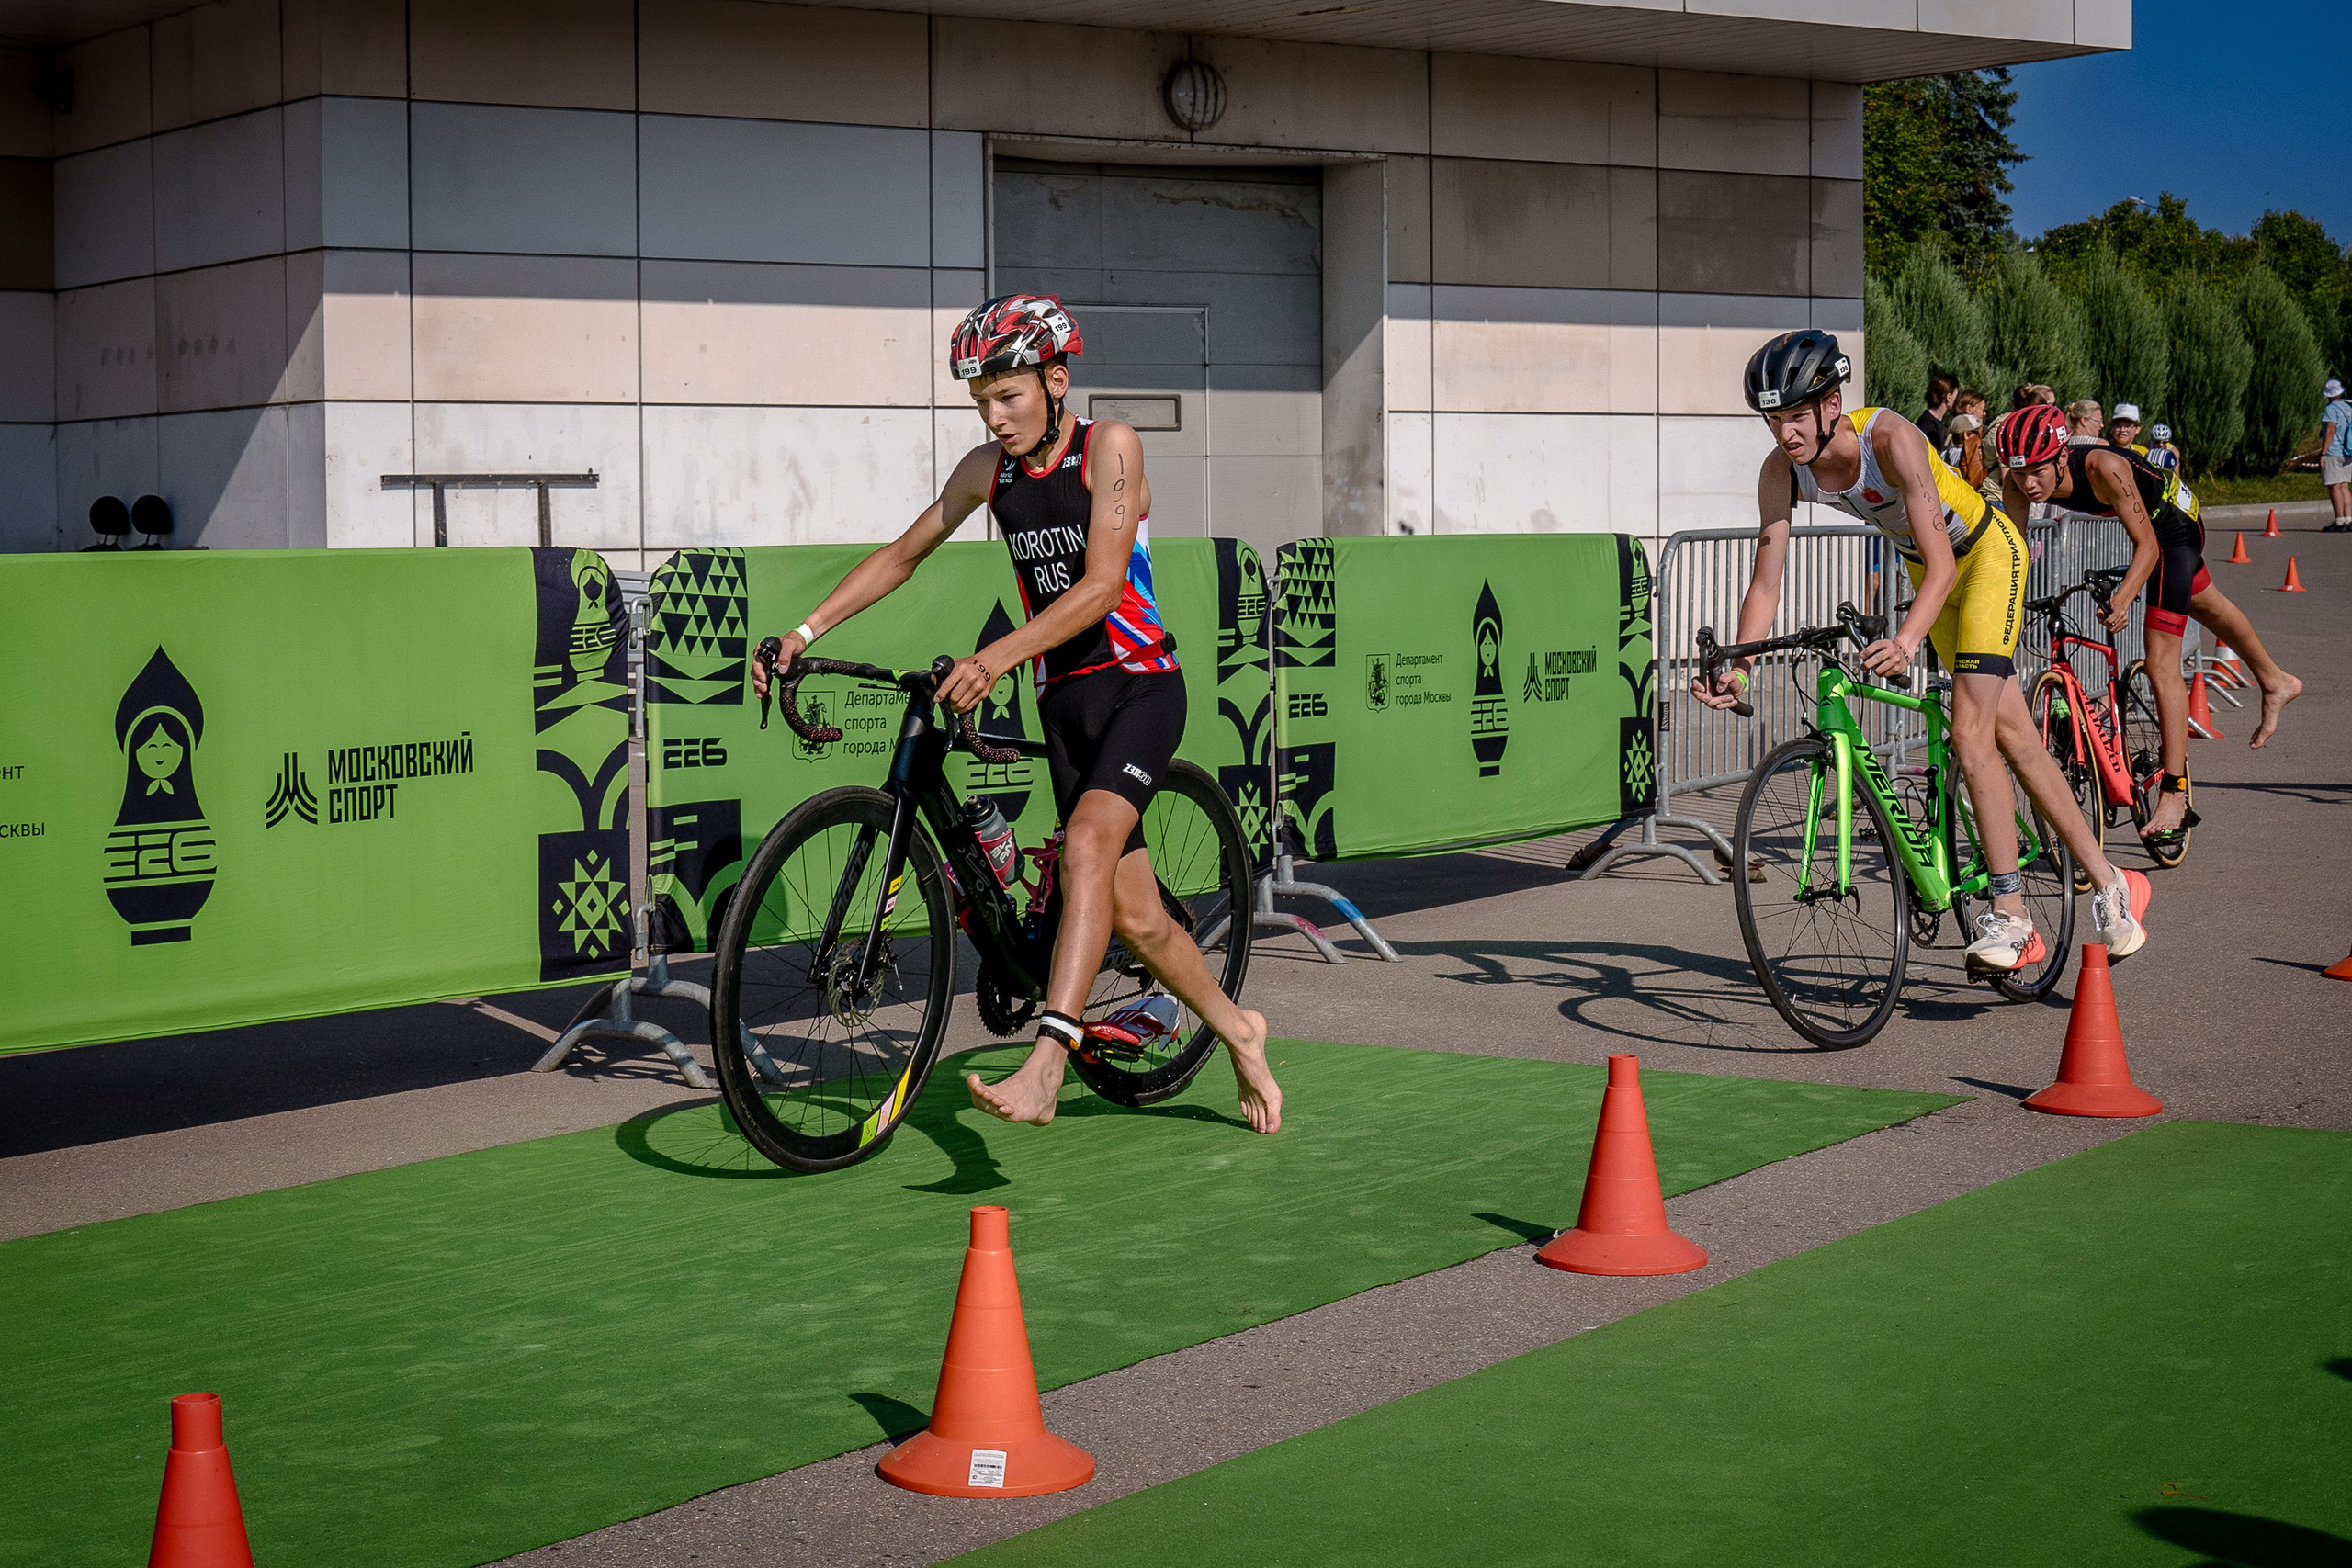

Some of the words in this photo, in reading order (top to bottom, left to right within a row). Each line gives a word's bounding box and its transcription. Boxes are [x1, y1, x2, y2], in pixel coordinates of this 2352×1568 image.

[1054, 322, 1068, 332] 199
[961, 367, 978, 376] 199
[1761, 398, 1777, 406] 136
[1917, 473, 1944, 531] 136
[1008, 524, 1087, 561] KOROTIN
[1993, 513, 2020, 570] ТРИАТЛОН
[1034, 561, 1071, 594] RUS
[2003, 570, 2020, 645] ФЕДЕРАЦИЯ
[972, 659, 991, 682] 199
[1396, 653, 1443, 668] Департамент
[1544, 645, 1597, 675] МОСКОВСКИЙ
[1396, 674, 1422, 688] спорта
[1544, 677, 1570, 702] СПОРТ
[844, 691, 910, 709] Департаме
[1396, 695, 1422, 707] города
[1423, 691, 1452, 703] Москвы
[844, 717, 887, 733] спорта
[328, 731, 473, 784] МОСКОВСКИЙ
[843, 741, 886, 758] города
[329, 784, 398, 824] СПОРТ
[1854, 744, 1935, 868] MERIDA
[0, 822, 45, 838] сквы
